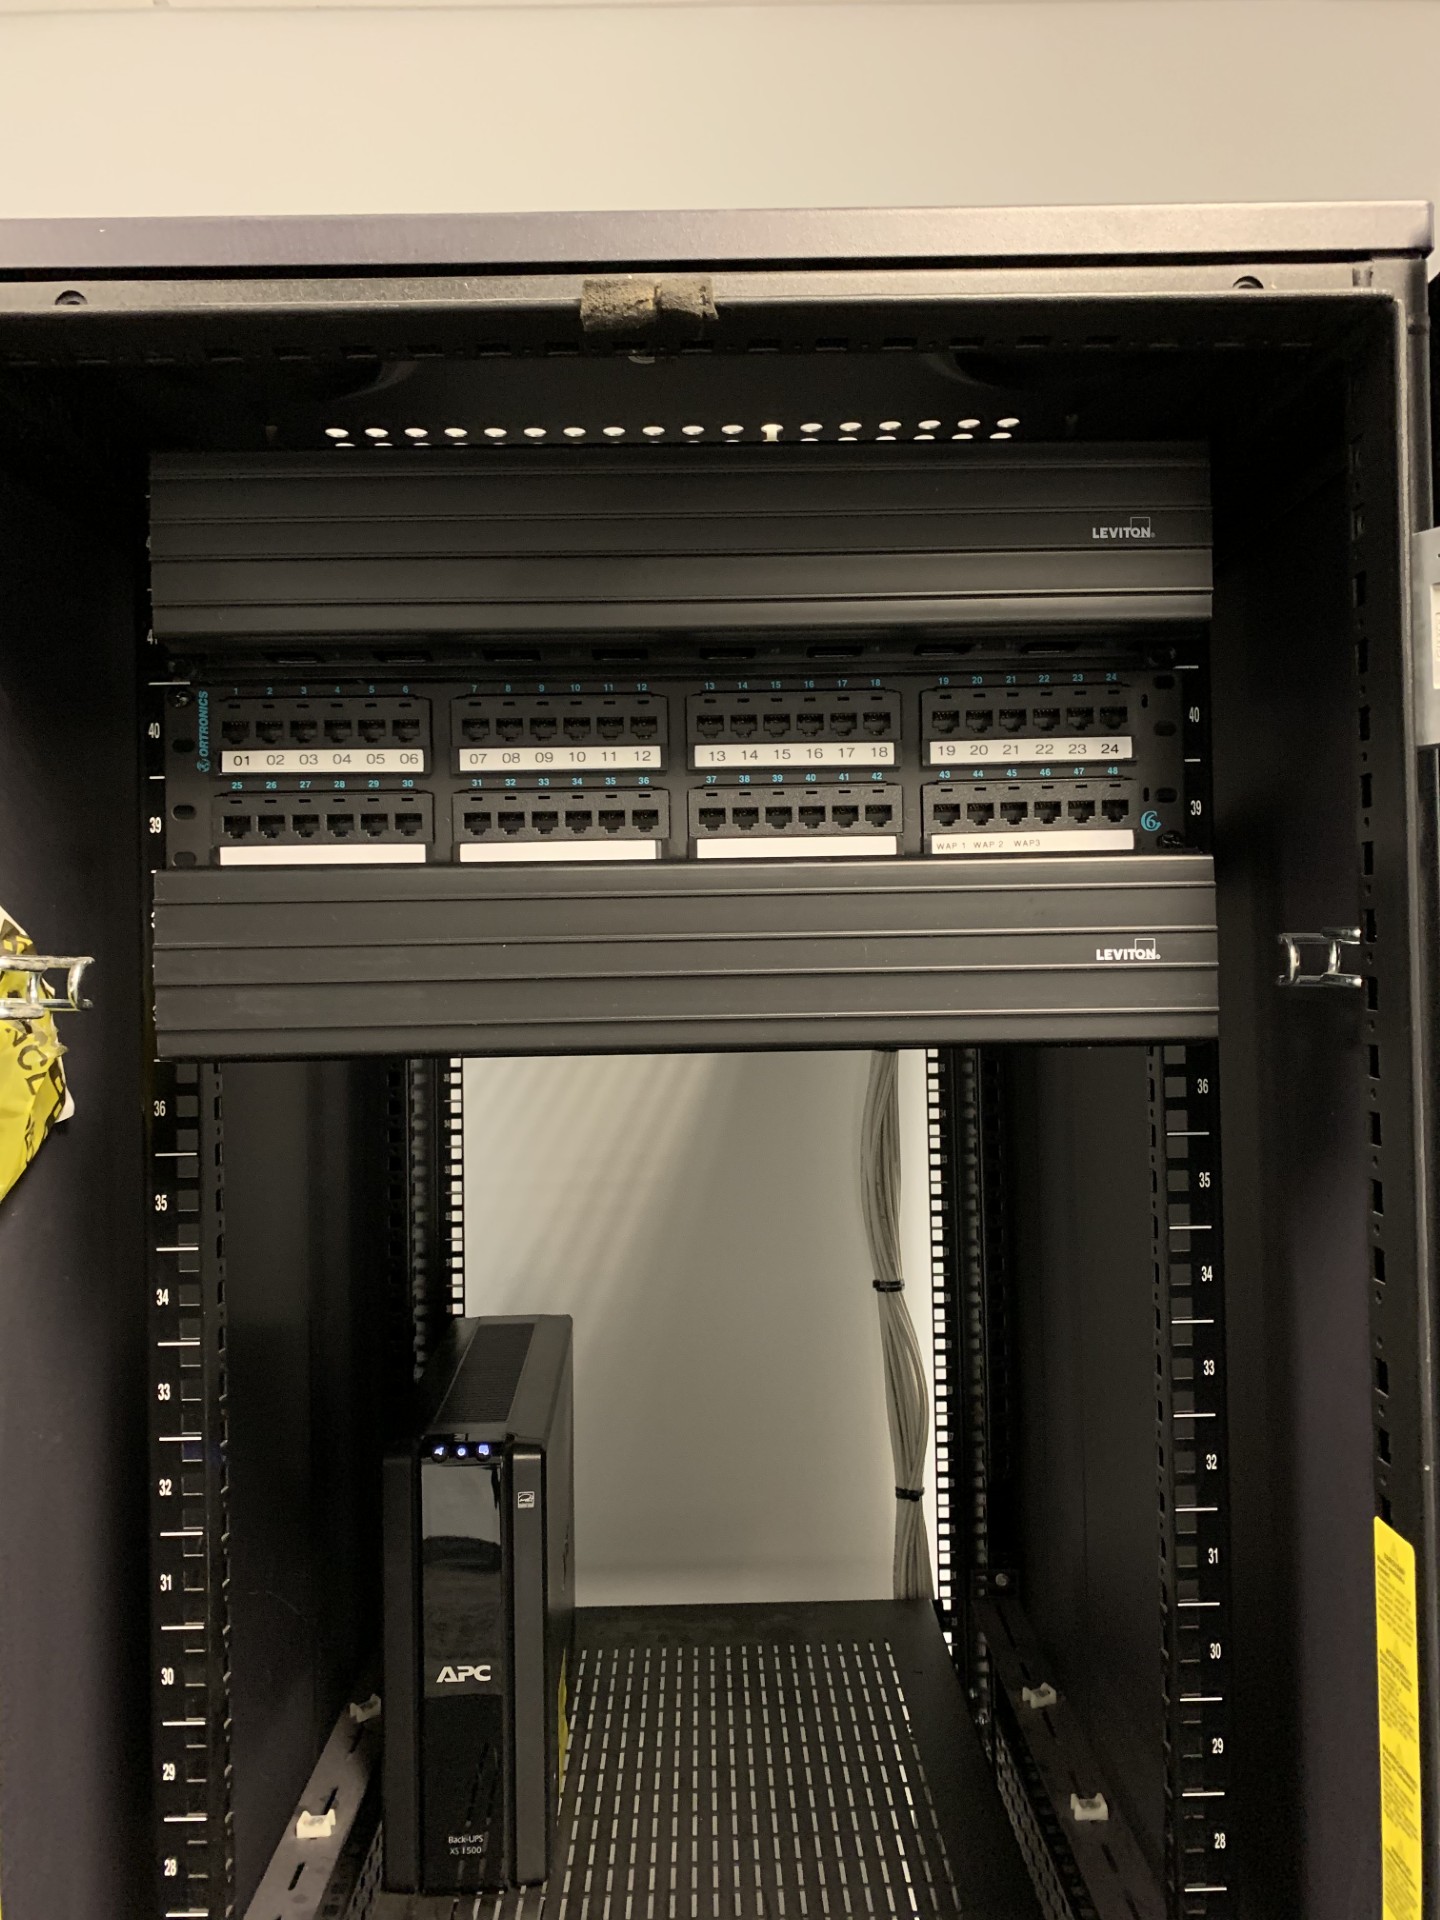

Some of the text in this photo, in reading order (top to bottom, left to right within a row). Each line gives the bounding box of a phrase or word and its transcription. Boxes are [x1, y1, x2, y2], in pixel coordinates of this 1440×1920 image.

[1091, 526, 1152, 539] LEVITON
[570, 683, 581, 692] 10
[603, 683, 614, 692] 11
[636, 683, 648, 692] 12
[704, 678, 881, 690] 13 14 15 16 17 18
[938, 672, 1118, 686] 19 20 21 22 23 24
[1189, 706, 1200, 723] 40
[148, 722, 161, 739] 40
[198, 690, 209, 758] ORTRONICS
[469, 750, 652, 765] 07 08 09 10 11 12
[709, 746, 889, 762] 13 14 15 16 17 18
[938, 743, 1120, 756] 19 20 21 22 23 24
[232, 753, 419, 767] 01 02 03 04 05 06
[705, 771, 883, 784] 37 38 39 40 41 42
[938, 766, 1119, 779] 43 44 45 46 47 48
[231, 779, 414, 790] 25 26 27 28 29 30
[471, 776, 650, 787] 31 32 33 34 35 36
[1190, 799, 1202, 816] 39
[149, 816, 162, 834] 39
[936, 842, 958, 850] WAP
[973, 841, 996, 849] WAP
[998, 840, 1004, 848] 2
[1013, 839, 1041, 848] WAP3
[1095, 948, 1157, 960] LEVITON
[1197, 1078, 1209, 1094] 36
[153, 1100, 166, 1117] 36
[1198, 1171, 1211, 1188] 35
[154, 1194, 168, 1212] 35
[1201, 1265, 1213, 1282] 34
[155, 1288, 170, 1307] 34
[1203, 1359, 1215, 1376] 33
[157, 1382, 171, 1401] 33
[1205, 1453, 1218, 1471] 32
[158, 1478, 173, 1497] 32
[1207, 1547, 1219, 1565] 31
[159, 1573, 173, 1592] 31
[1209, 1642, 1222, 1660] 30
[160, 1666, 175, 1686] 30
[436, 1664, 492, 1683] APC
[1211, 1737, 1224, 1755] 29
[162, 1762, 177, 1781] 29
[448, 1834, 484, 1844] Back-UPS
[1214, 1832, 1227, 1850] 28
[449, 1846, 482, 1855] XS 1500
[163, 1857, 178, 1877] 28
